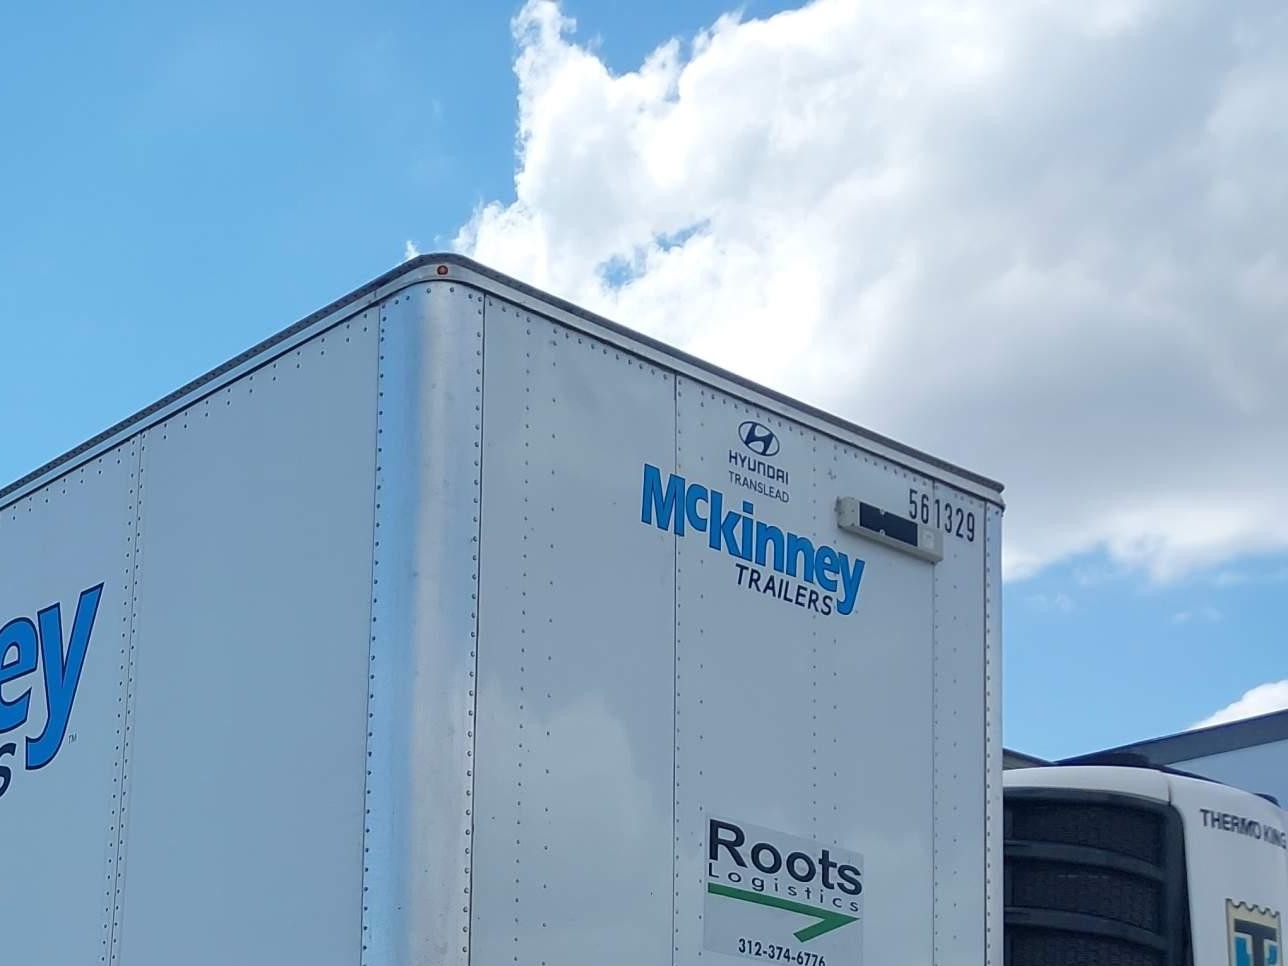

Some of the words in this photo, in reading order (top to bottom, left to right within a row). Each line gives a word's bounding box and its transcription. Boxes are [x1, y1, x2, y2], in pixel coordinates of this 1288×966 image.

[729, 450, 789, 485] HYUNDAI
[729, 470, 790, 503] TRANSLEAD
[641, 463, 865, 615] Mckinney
[908, 488, 975, 542] 561329
[735, 563, 833, 616] TRAILERS
[1200, 808, 1262, 840] THERMO
[1263, 824, 1287, 850] KING
[709, 818, 863, 896] Roots
[708, 862, 859, 912] Logistics
